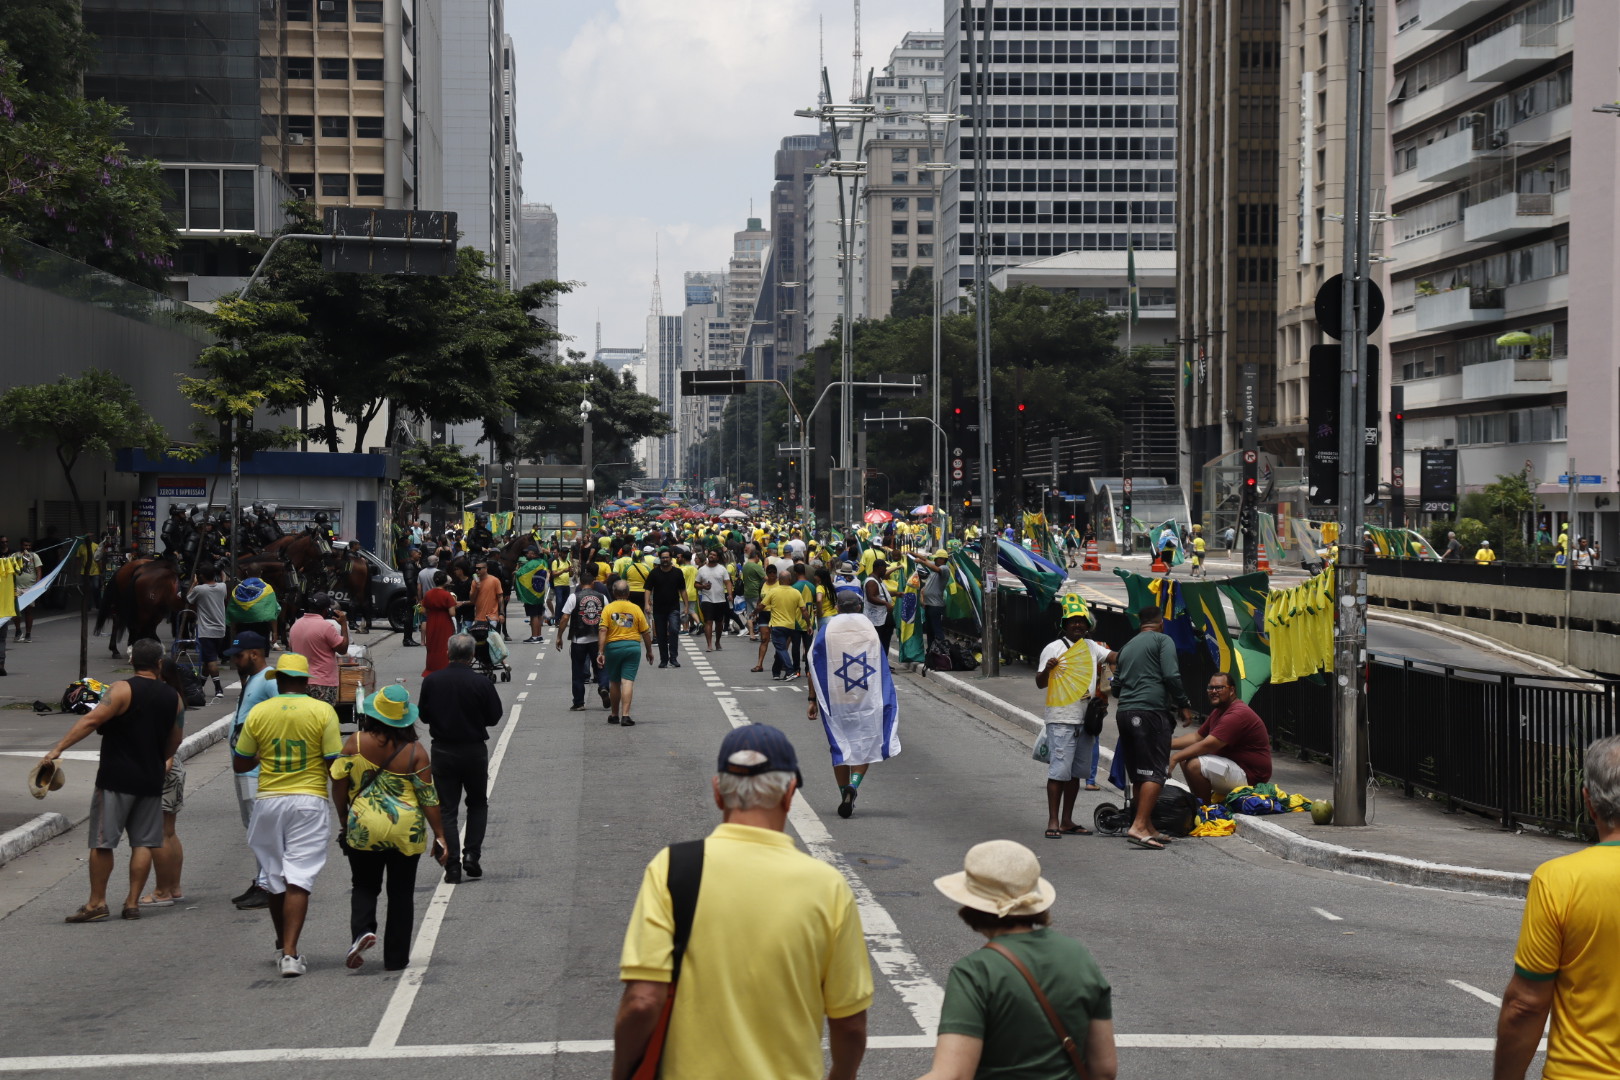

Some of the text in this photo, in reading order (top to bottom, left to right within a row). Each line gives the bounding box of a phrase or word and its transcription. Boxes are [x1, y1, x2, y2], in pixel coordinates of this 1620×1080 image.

[1245, 385, 1255, 423] Augusta
[1425, 502, 1449, 511] 29°C
[271, 738, 307, 773] 10
